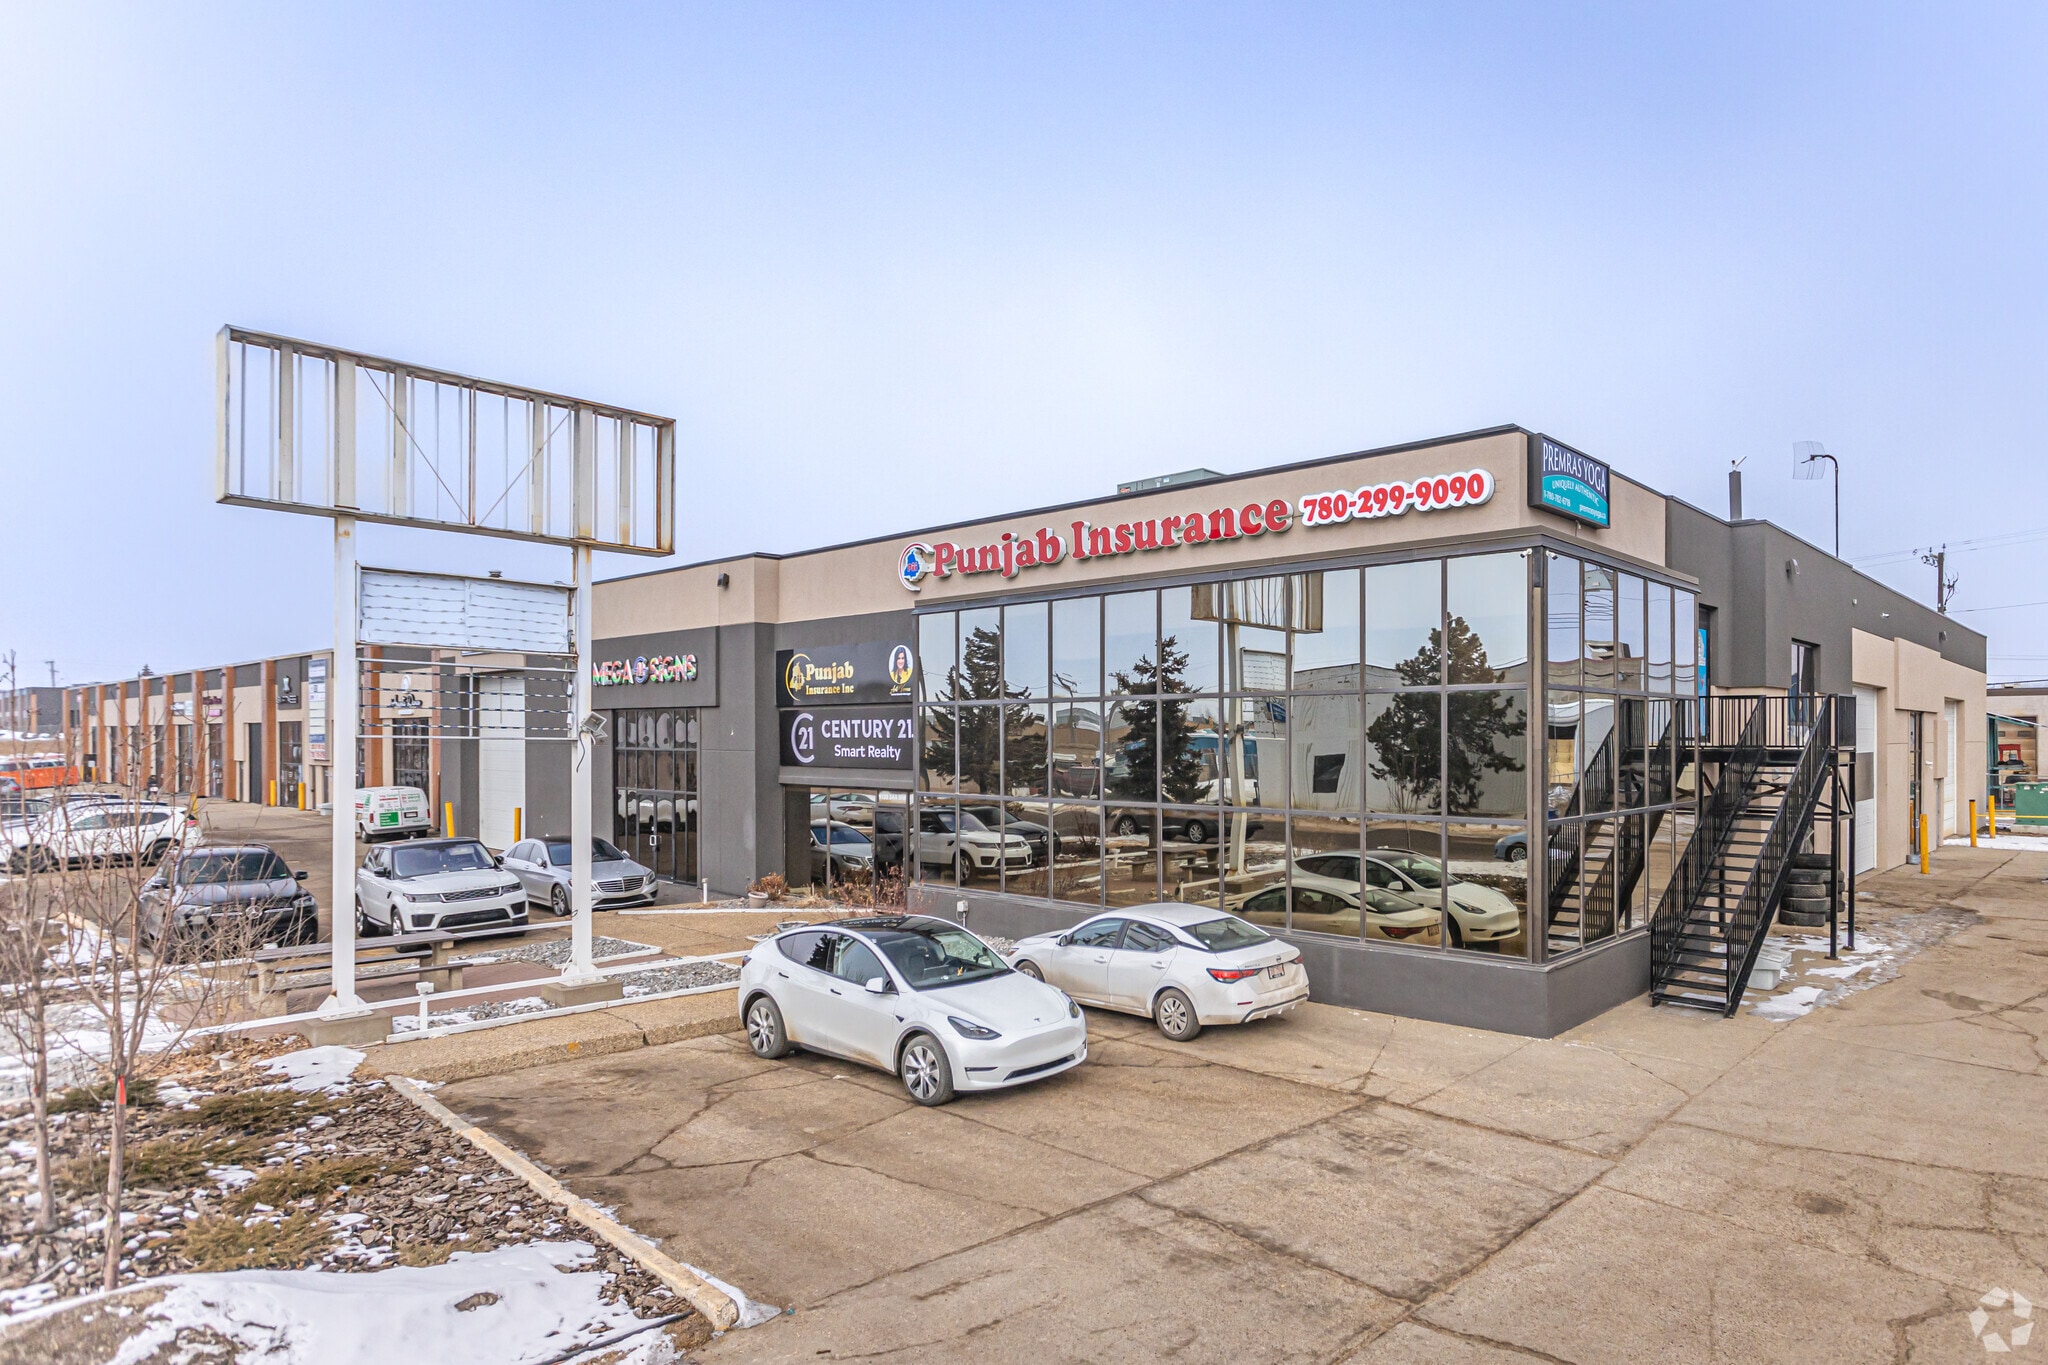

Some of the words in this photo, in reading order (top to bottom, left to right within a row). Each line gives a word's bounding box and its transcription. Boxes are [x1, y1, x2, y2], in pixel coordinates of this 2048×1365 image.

[1543, 442, 1582, 478] PREMRAS
[1583, 459, 1607, 497] YOGA
[1302, 471, 1487, 524] 780-299-9090
[1575, 482, 1600, 507] AUTHENTIC
[932, 528, 1066, 578] Punjab
[1072, 499, 1292, 560] Insurance
[592, 659, 634, 686] MEGA
[649, 654, 698, 683] SIGNS
[805, 661, 854, 684] Punjab
[805, 684, 840, 695] Insurance
[841, 683, 855, 694] Inc
[821, 719, 894, 739] CENTURY
[834, 745, 866, 758] Smart
[868, 744, 901, 761] Realty
